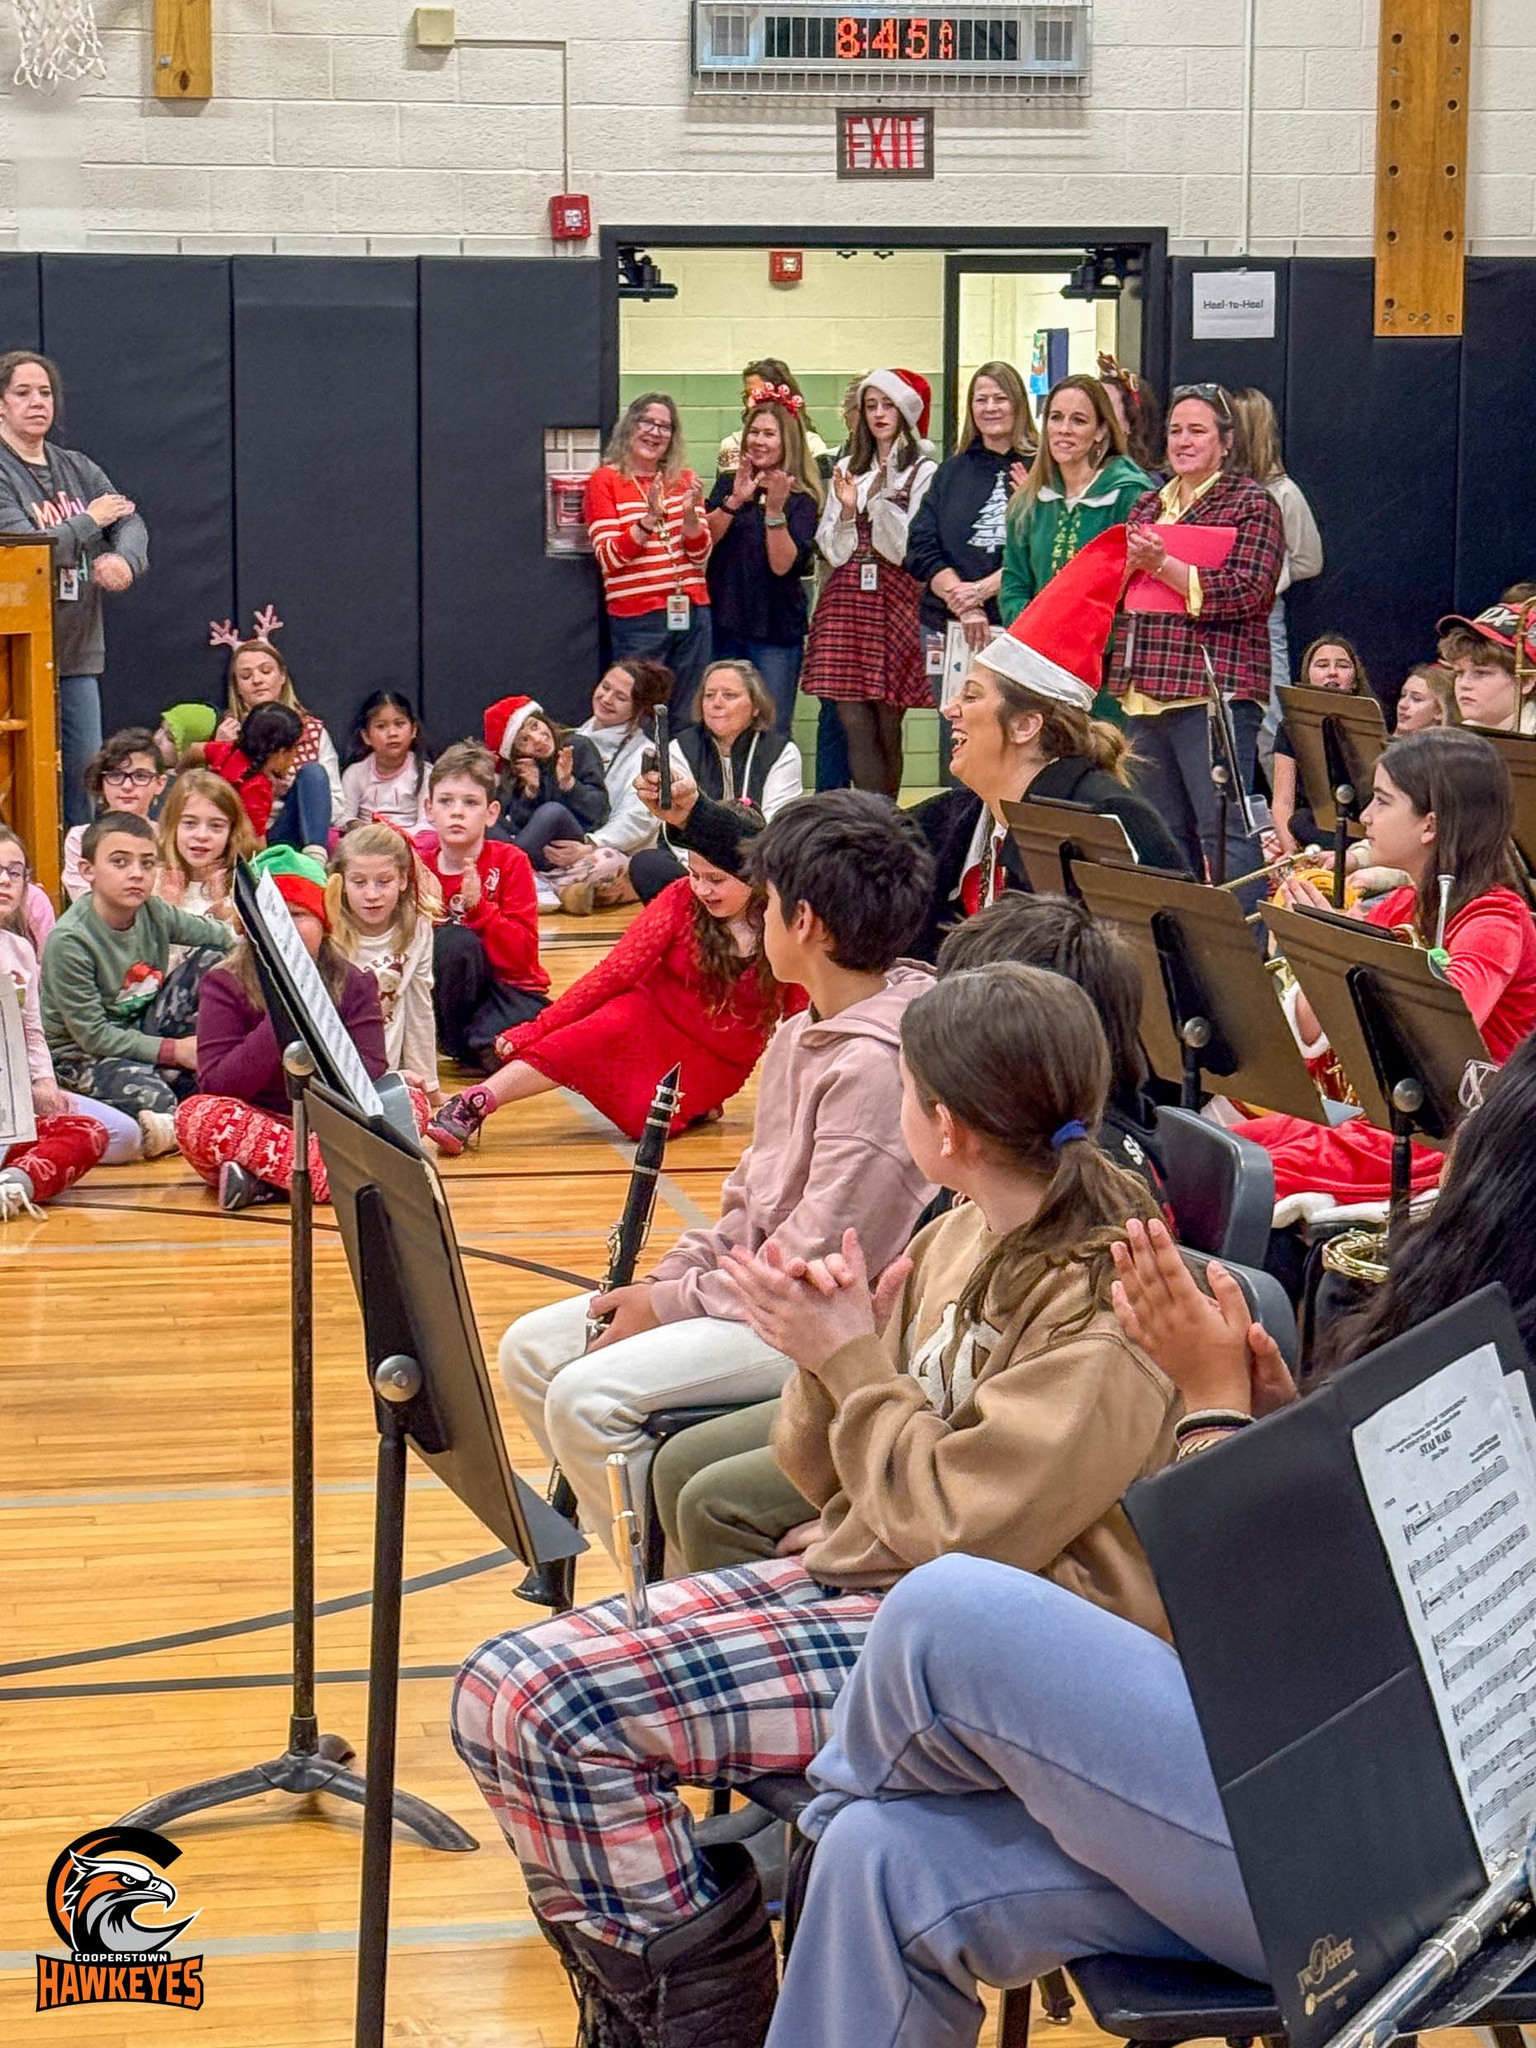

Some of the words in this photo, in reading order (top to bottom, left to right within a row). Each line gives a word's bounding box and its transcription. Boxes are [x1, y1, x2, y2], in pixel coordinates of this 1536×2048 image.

[836, 17, 929, 59] 8:45
[847, 117, 919, 169] EXIT
[1203, 299, 1264, 310] Heel-to-Heel
